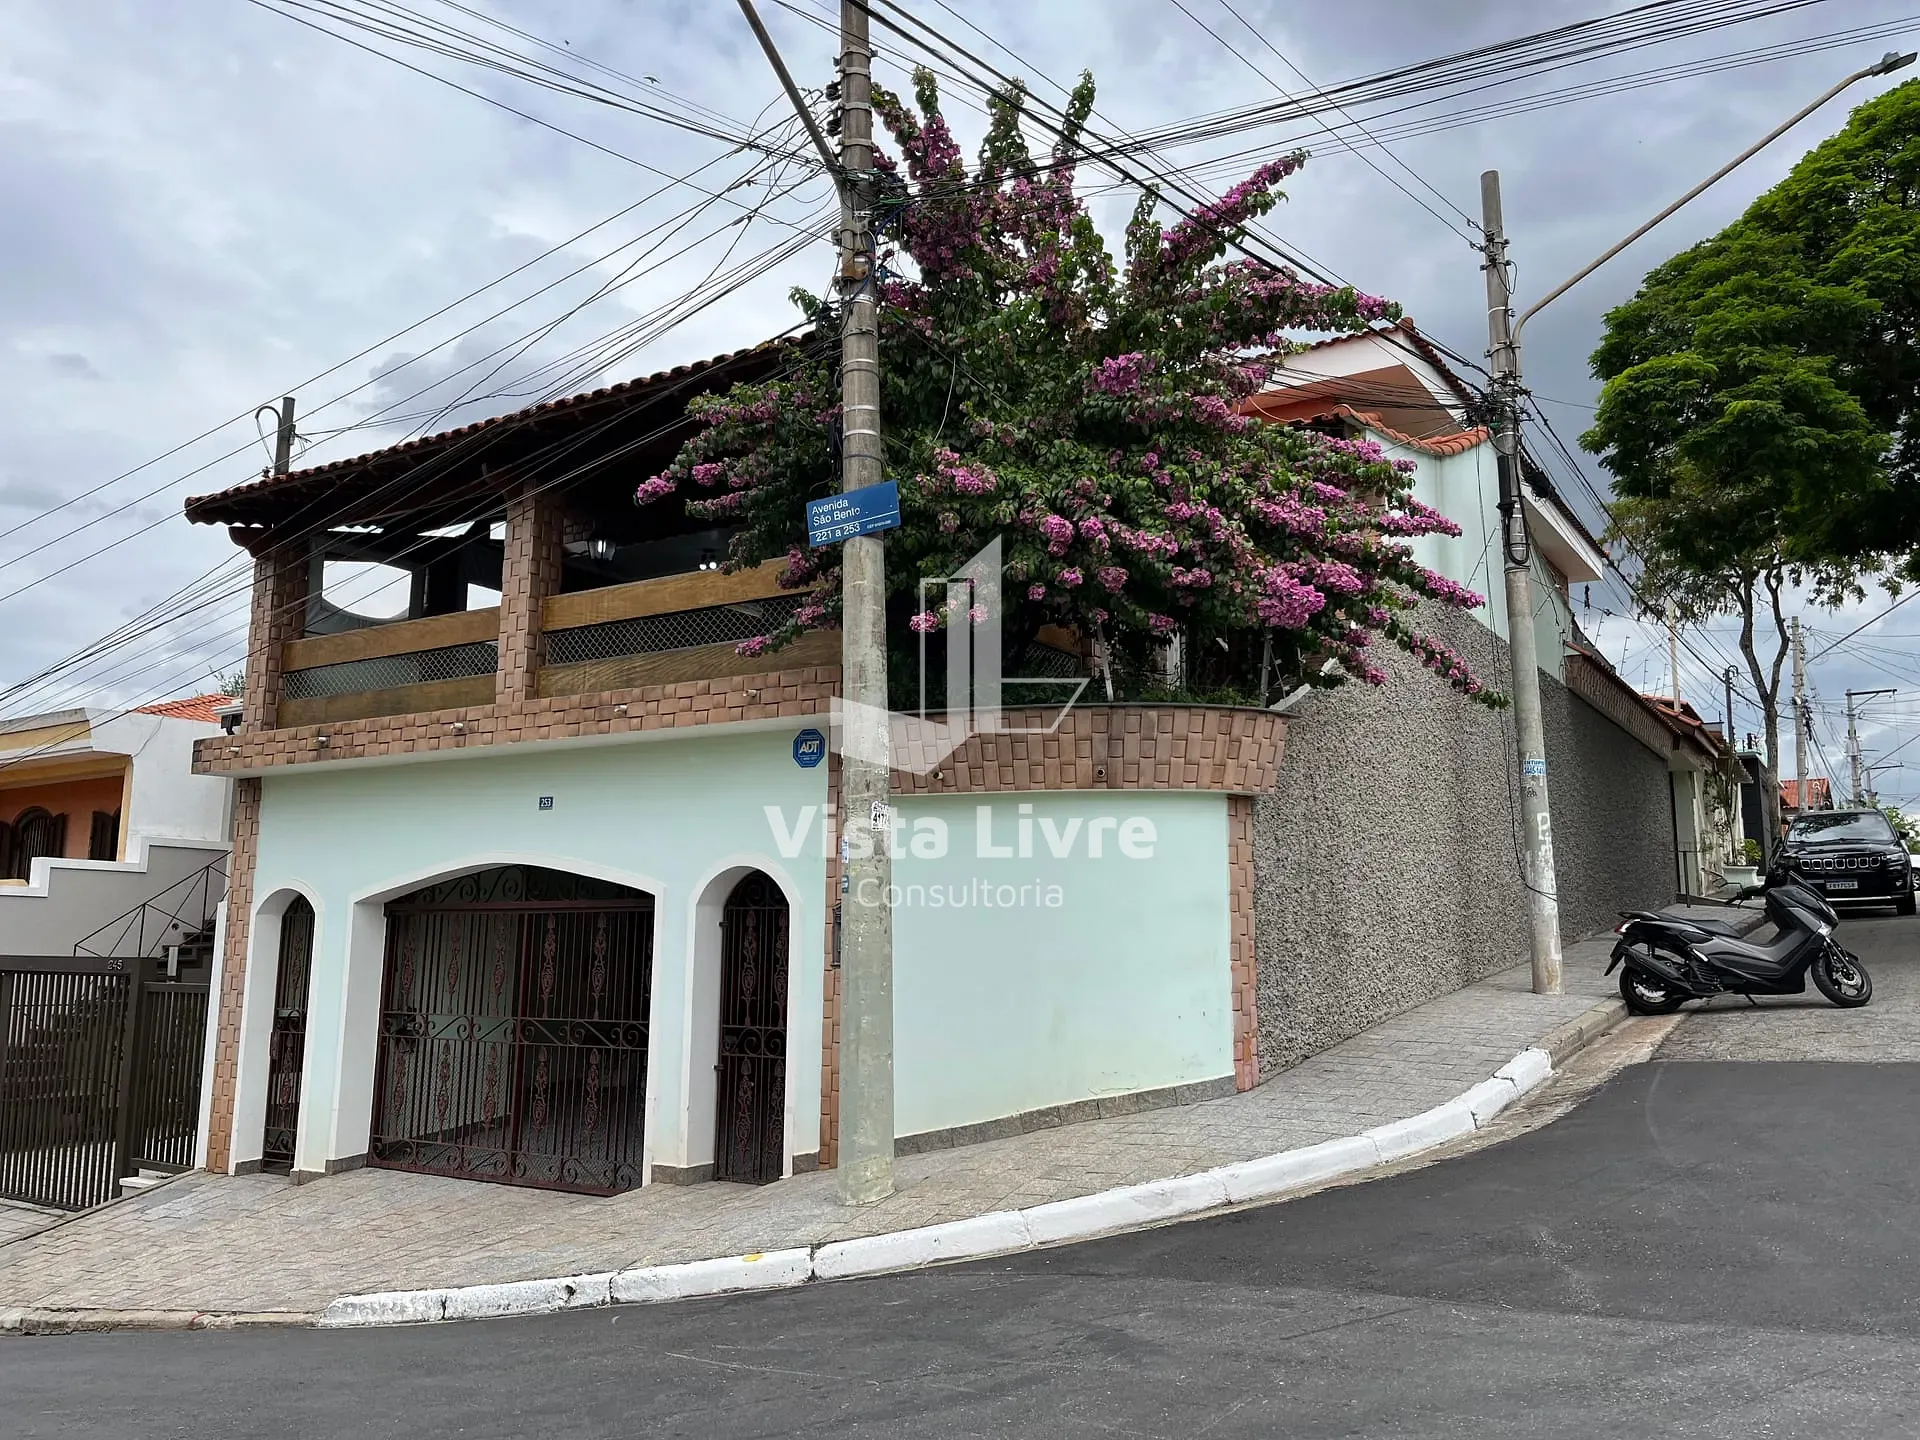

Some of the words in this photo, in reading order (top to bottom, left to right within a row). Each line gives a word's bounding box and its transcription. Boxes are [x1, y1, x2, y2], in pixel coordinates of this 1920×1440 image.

[812, 499, 848, 515] Avenida
[813, 514, 832, 526] São
[834, 507, 860, 521] Bento
[816, 530, 832, 542] 221
[835, 529, 841, 537] a
[843, 523, 860, 535] 253
[799, 740, 819, 753] ADT
[541, 798, 552, 807] 253
[107, 959, 123, 970] 245
